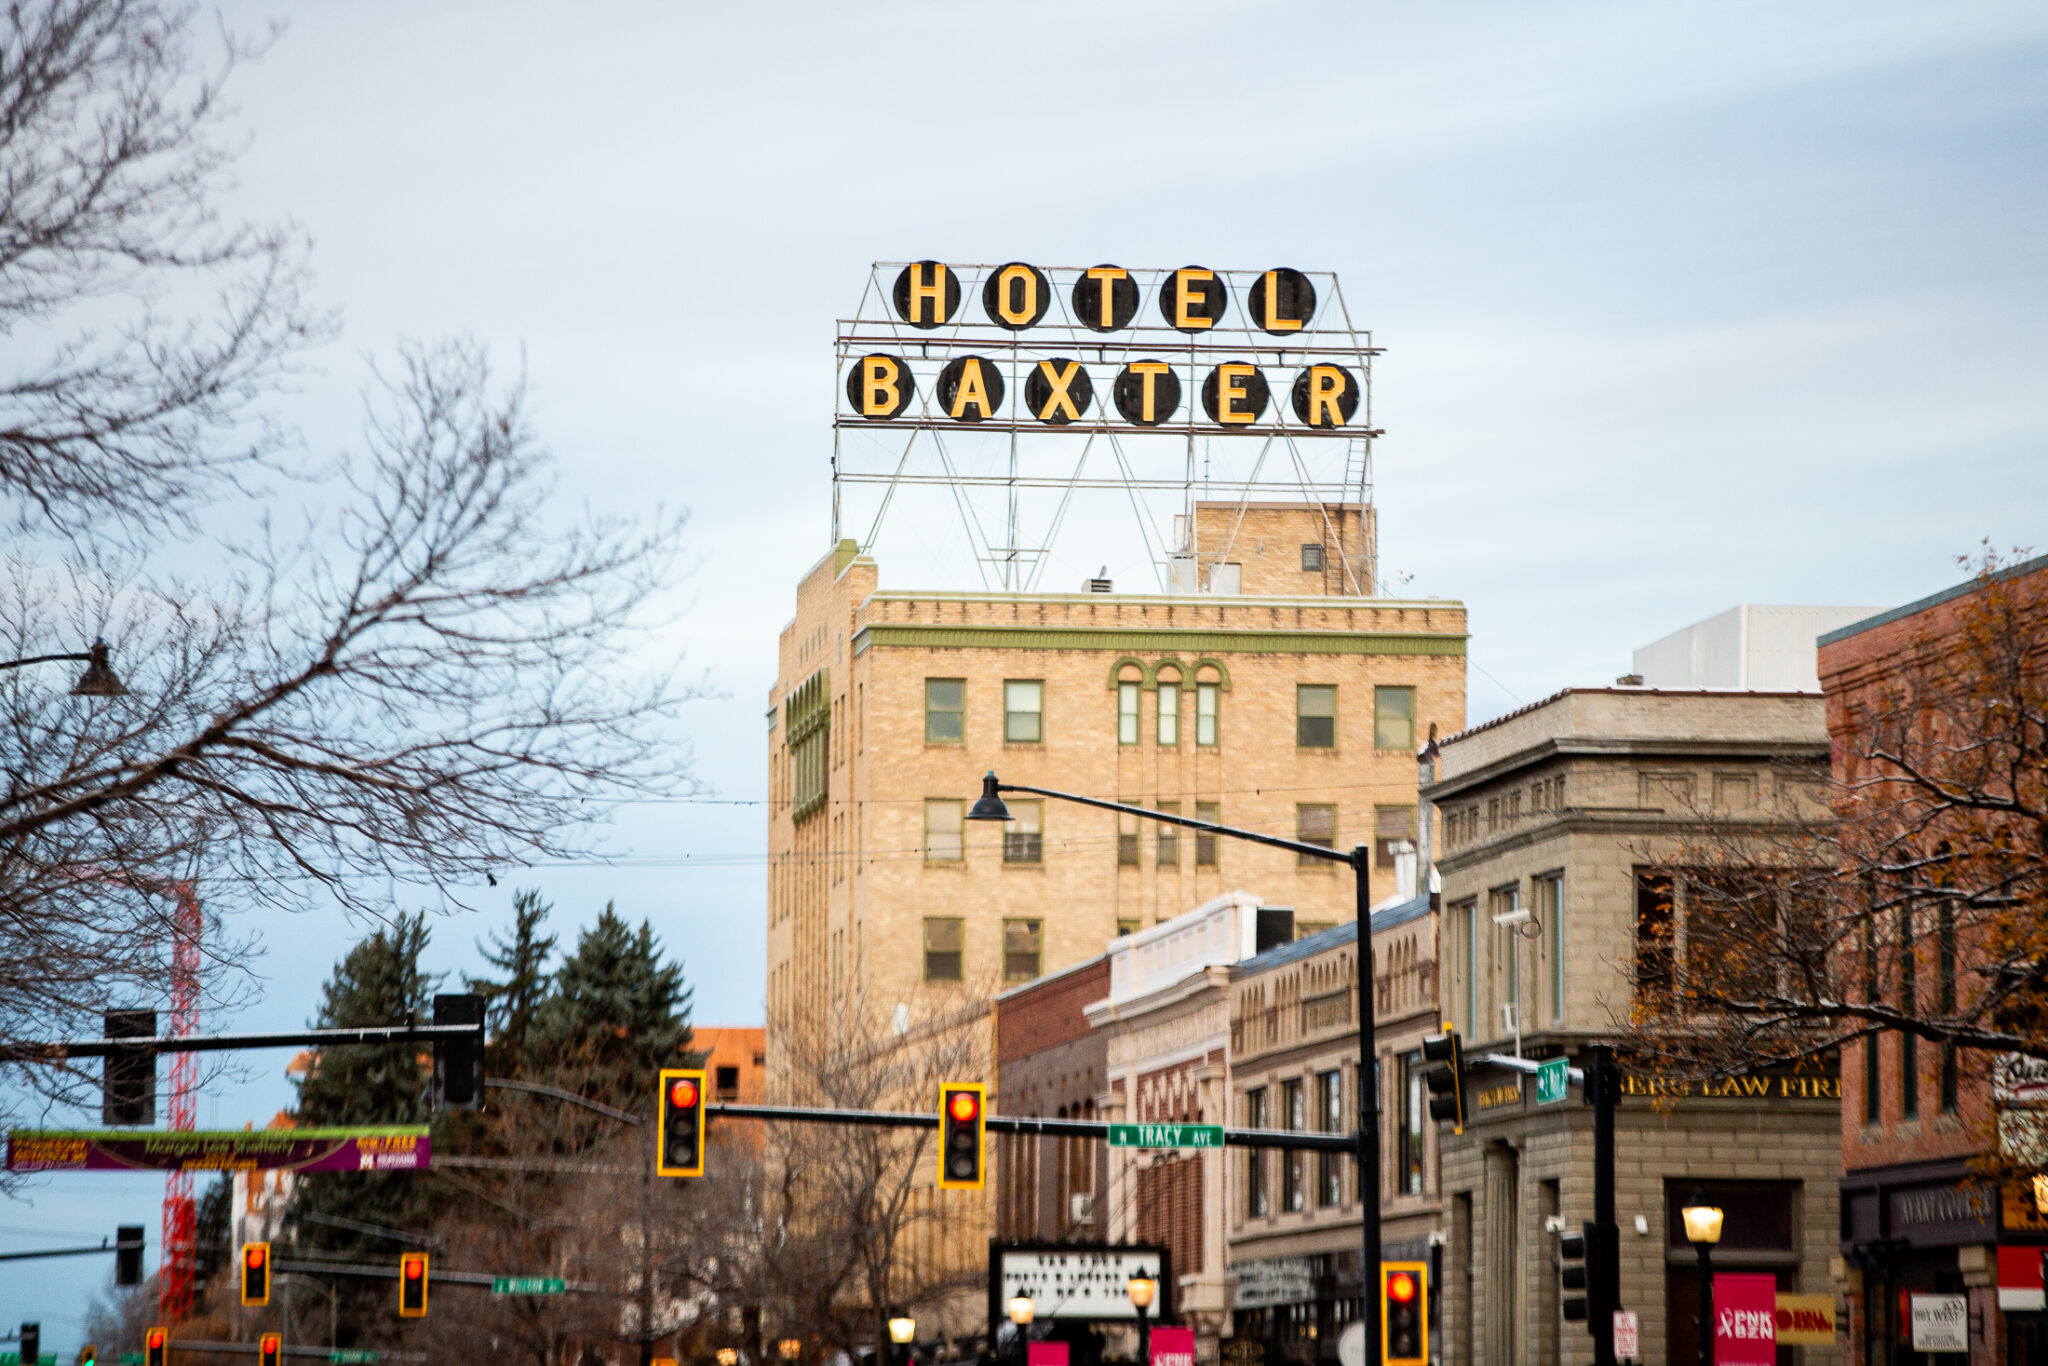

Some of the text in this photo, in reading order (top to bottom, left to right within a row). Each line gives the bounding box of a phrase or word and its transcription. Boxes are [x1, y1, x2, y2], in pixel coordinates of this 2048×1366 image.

[910, 263, 1302, 330] HOTEL
[863, 356, 1345, 426] BAXTER
[1620, 1074, 1690, 1096] ERG
[1702, 1076, 1771, 1097] LAW
[1119, 1126, 1213, 1146] N TRACY AVE
[1735, 1310, 1772, 1325] PNK
[1735, 1325, 1773, 1340] BZN
